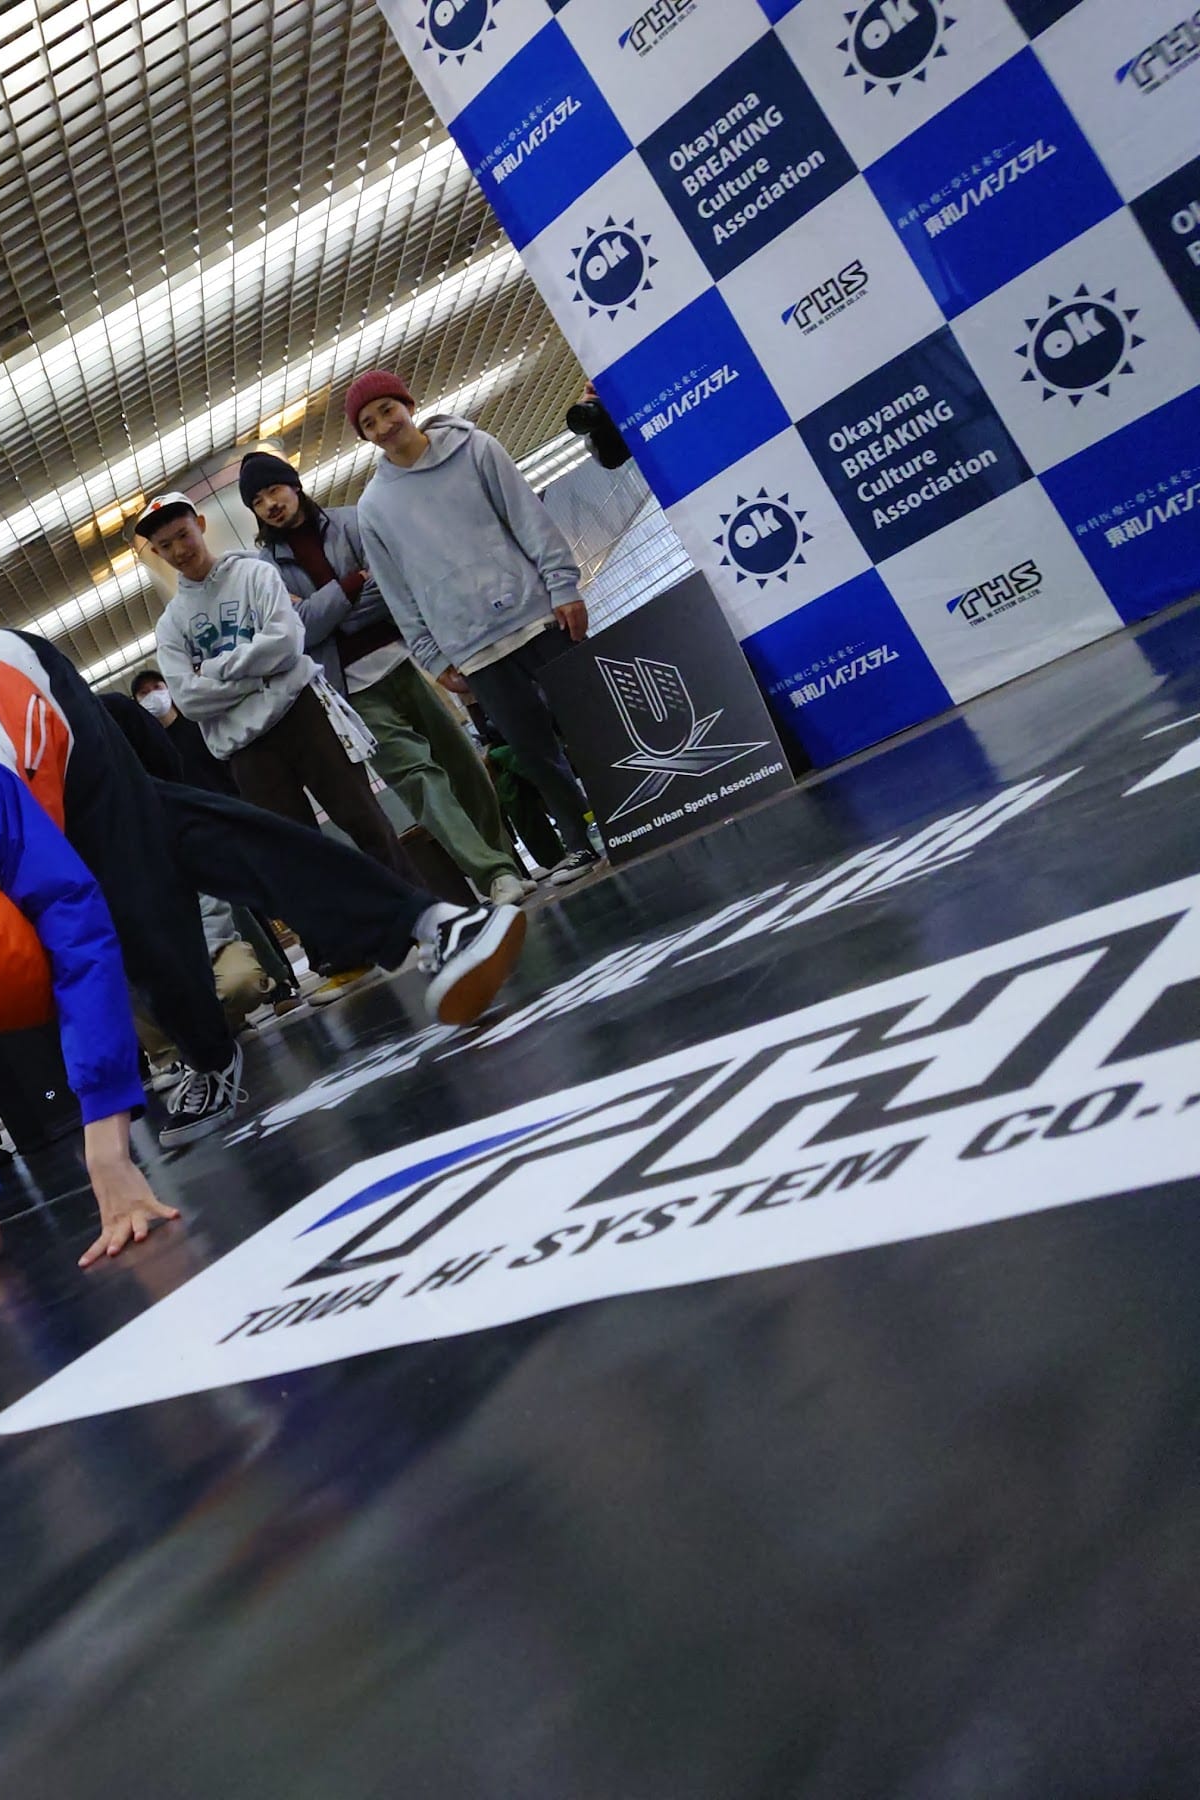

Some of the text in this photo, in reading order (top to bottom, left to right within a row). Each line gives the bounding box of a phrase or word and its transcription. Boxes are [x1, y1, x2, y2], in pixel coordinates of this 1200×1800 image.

[669, 92, 760, 171] Okayama
[681, 105, 784, 197] BREAKING
[697, 157, 770, 219] Culture
[712, 150, 826, 245] Association
[781, 259, 868, 329] THS
[828, 384, 930, 452] Okayama
[841, 399, 954, 479] BREAKING
[857, 449, 938, 502] Culture
[871, 449, 998, 529] Association
[946, 559, 1042, 620] THS
[608, 762, 783, 849] Okayama Urban Sports Association
[216, 1272, 403, 1345] TOWA
[506, 1135, 930, 1269] SYSTEM
